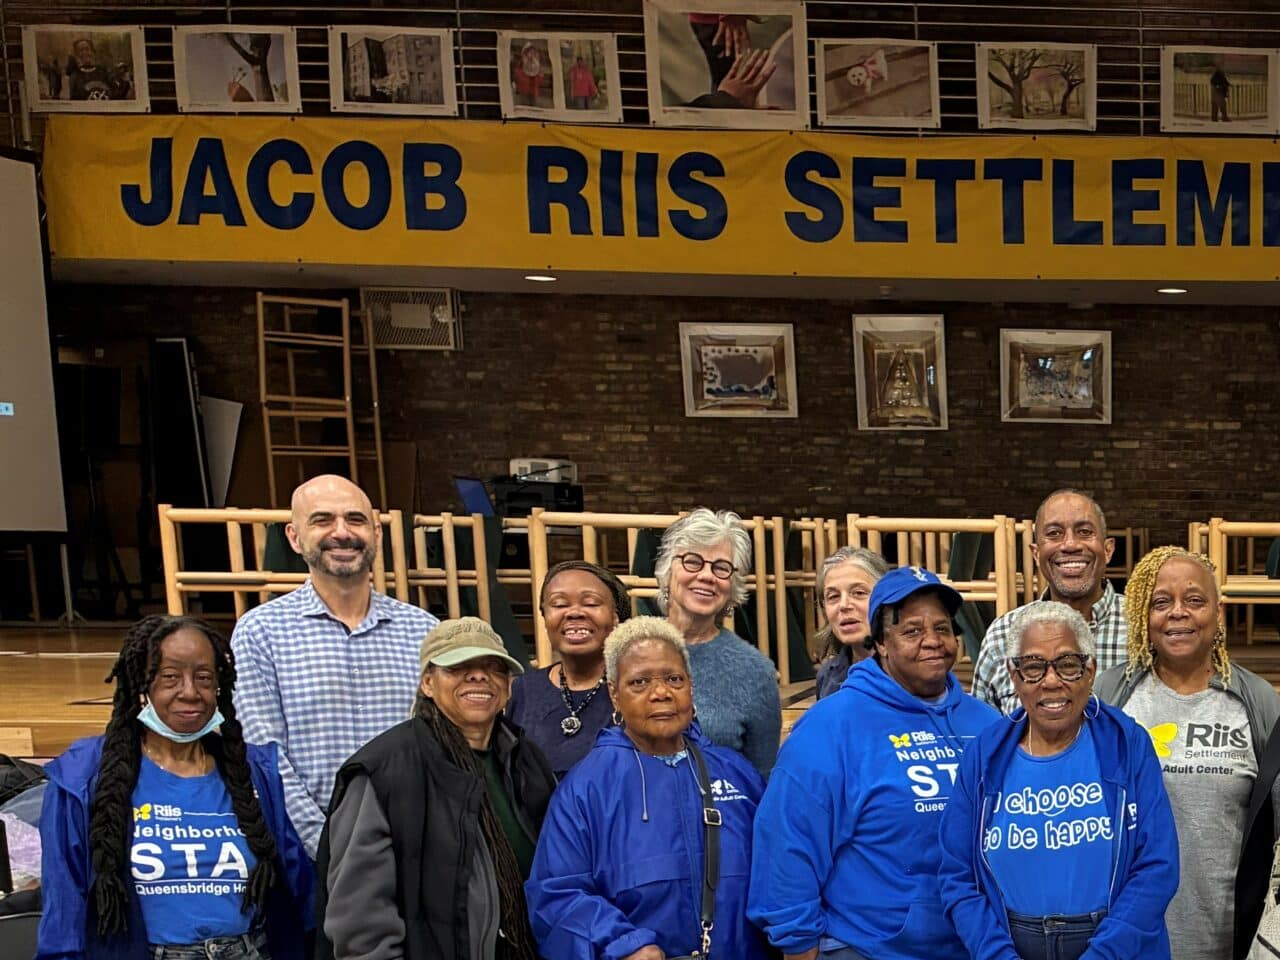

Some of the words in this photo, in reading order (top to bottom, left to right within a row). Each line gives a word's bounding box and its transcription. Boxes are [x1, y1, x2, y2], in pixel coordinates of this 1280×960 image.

[121, 137, 468, 231] JACOB
[527, 145, 728, 241] RIIS
[911, 731, 936, 743] Riis
[1185, 722, 1249, 749] Riis
[896, 746, 963, 762] Neighb
[1184, 750, 1248, 762] Settlement
[1163, 765, 1194, 775] Adult
[1196, 764, 1235, 776] Center
[1005, 783, 1103, 815] choose
[153, 803, 182, 817] Riis
[914, 802, 948, 813] Quee
[1008, 823, 1038, 850] be
[1044, 816, 1114, 850] happy
[136, 882, 231, 897] Queensbridge
